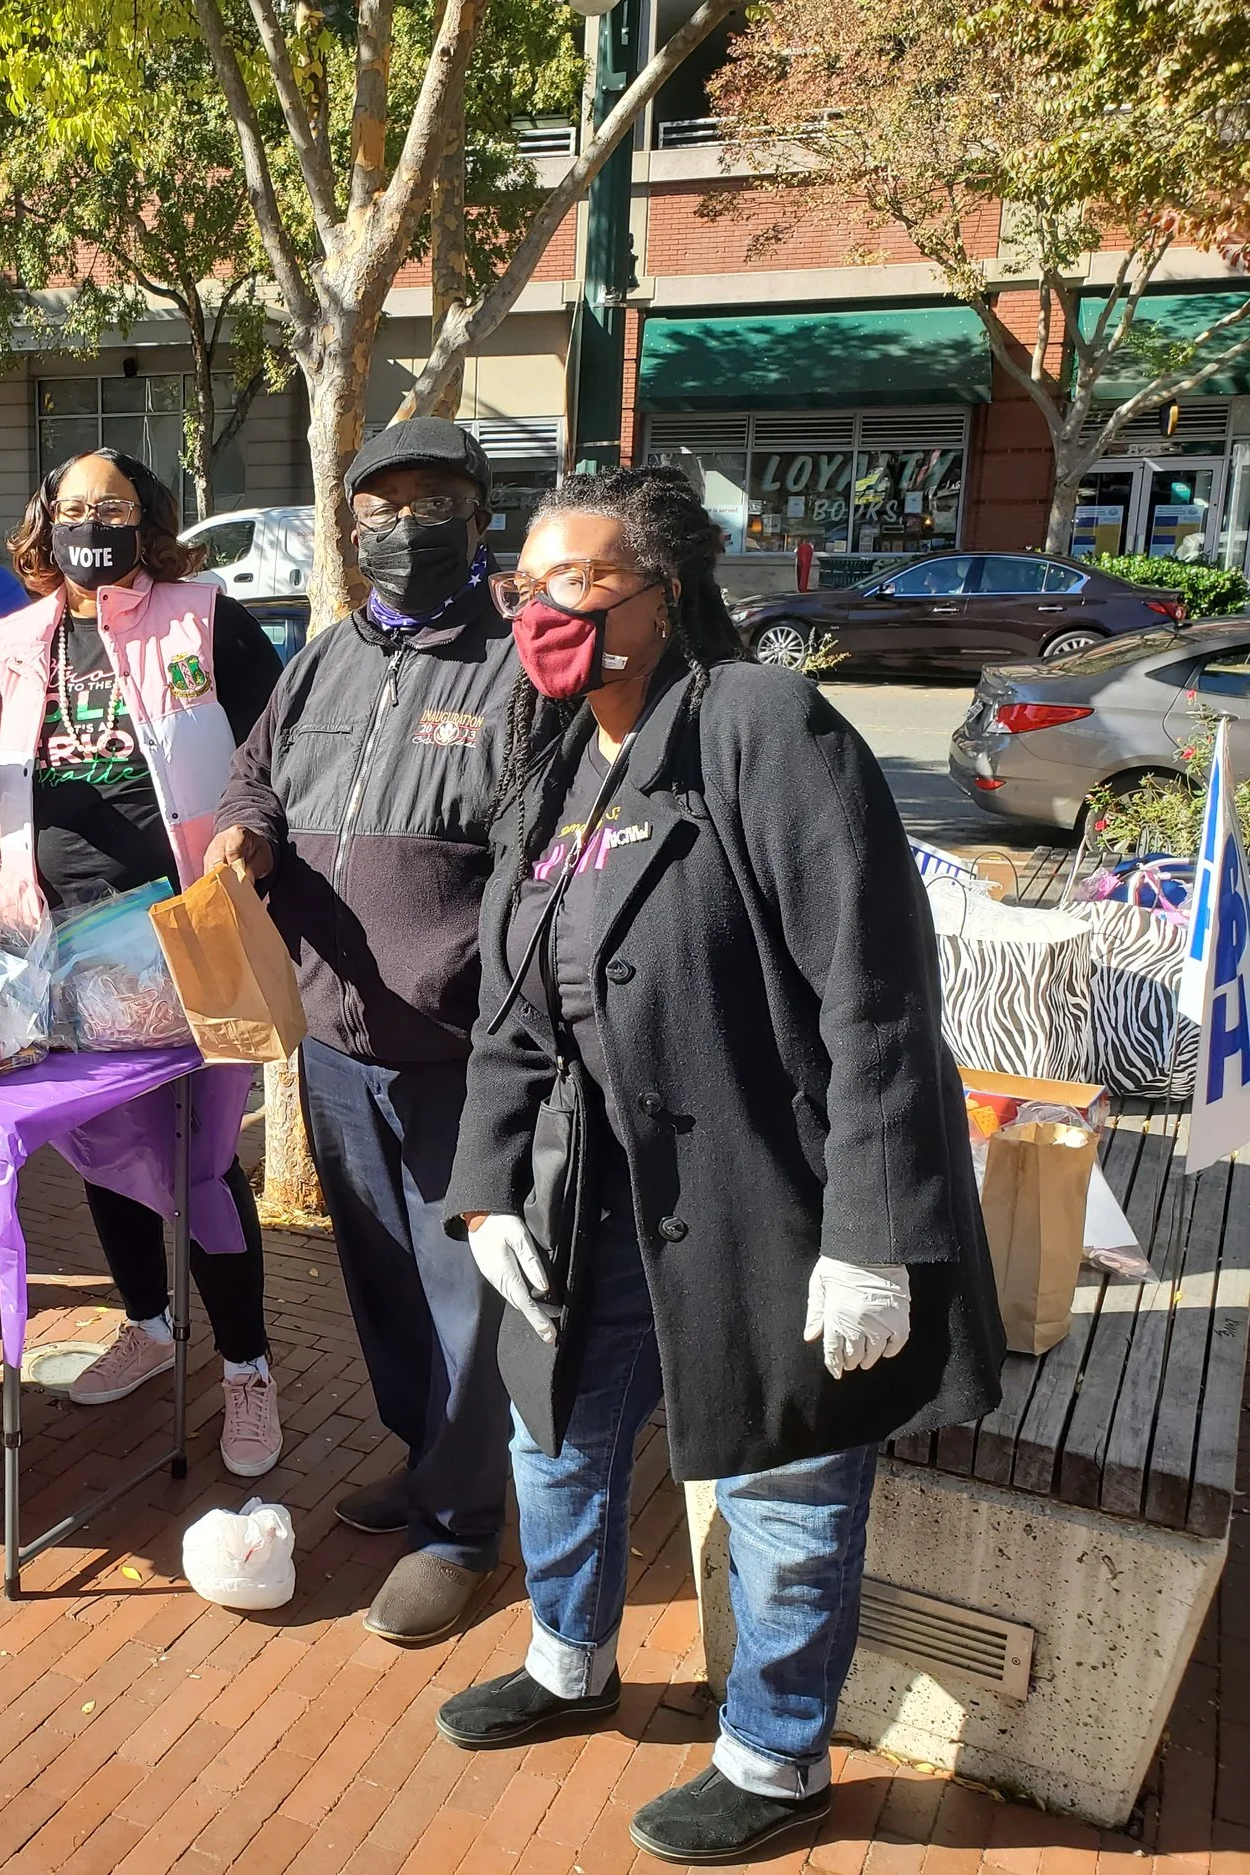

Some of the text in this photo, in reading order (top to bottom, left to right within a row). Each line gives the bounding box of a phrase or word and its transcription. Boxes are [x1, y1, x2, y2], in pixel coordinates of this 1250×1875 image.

[762, 451, 961, 492] LOYALTY
[69, 546, 113, 568] VOTE
[67, 680, 113, 692] TO THE
[421, 710, 484, 727] INAUGURATION
[419, 724, 477, 739] 20 13
